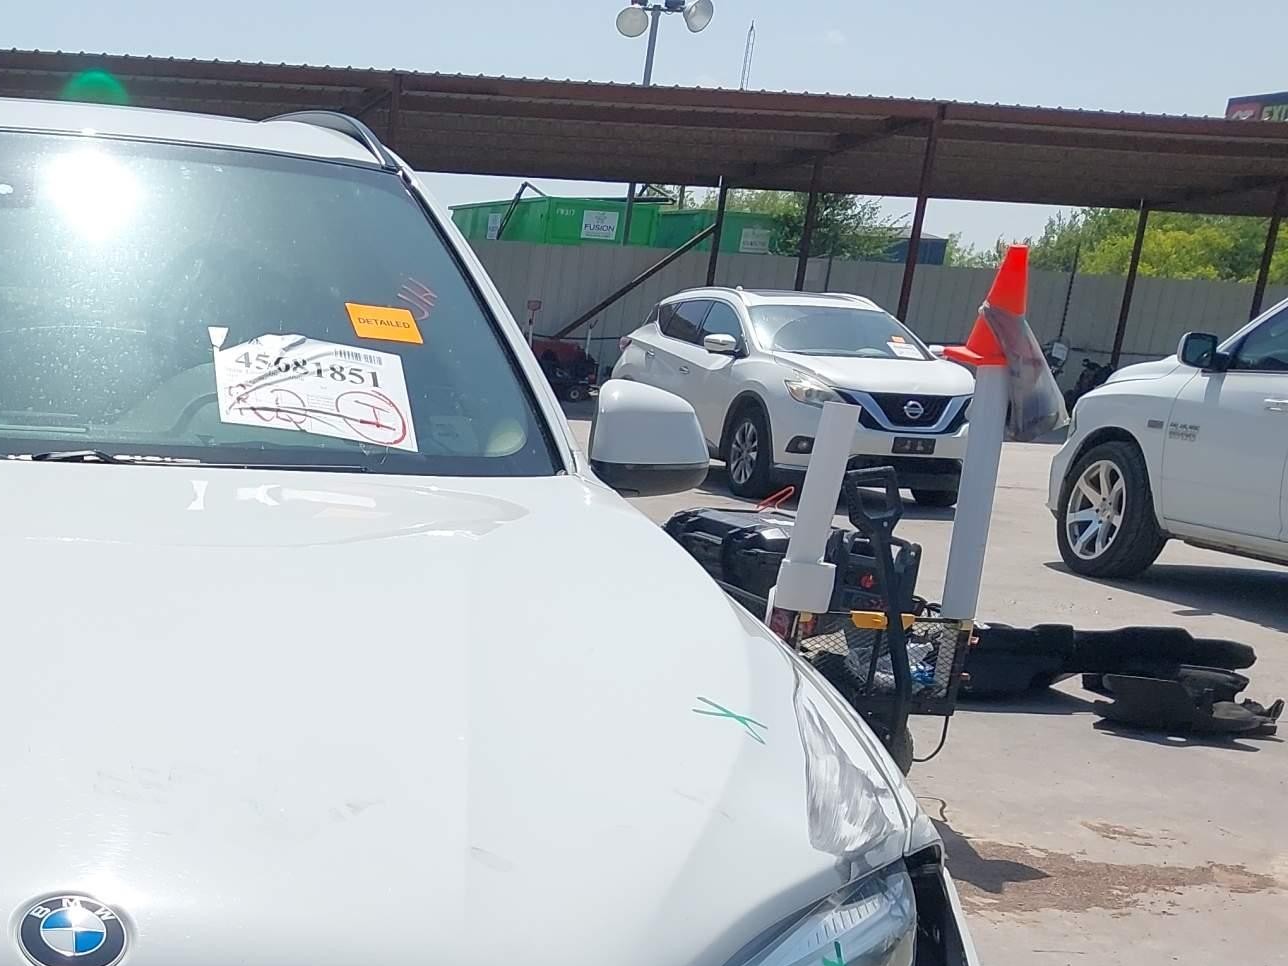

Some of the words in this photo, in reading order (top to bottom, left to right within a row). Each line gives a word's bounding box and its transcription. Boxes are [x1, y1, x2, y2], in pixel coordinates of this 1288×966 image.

[584, 223, 615, 232] FUSION
[357, 316, 411, 330] DETAILED
[235, 351, 381, 389] 45681851
